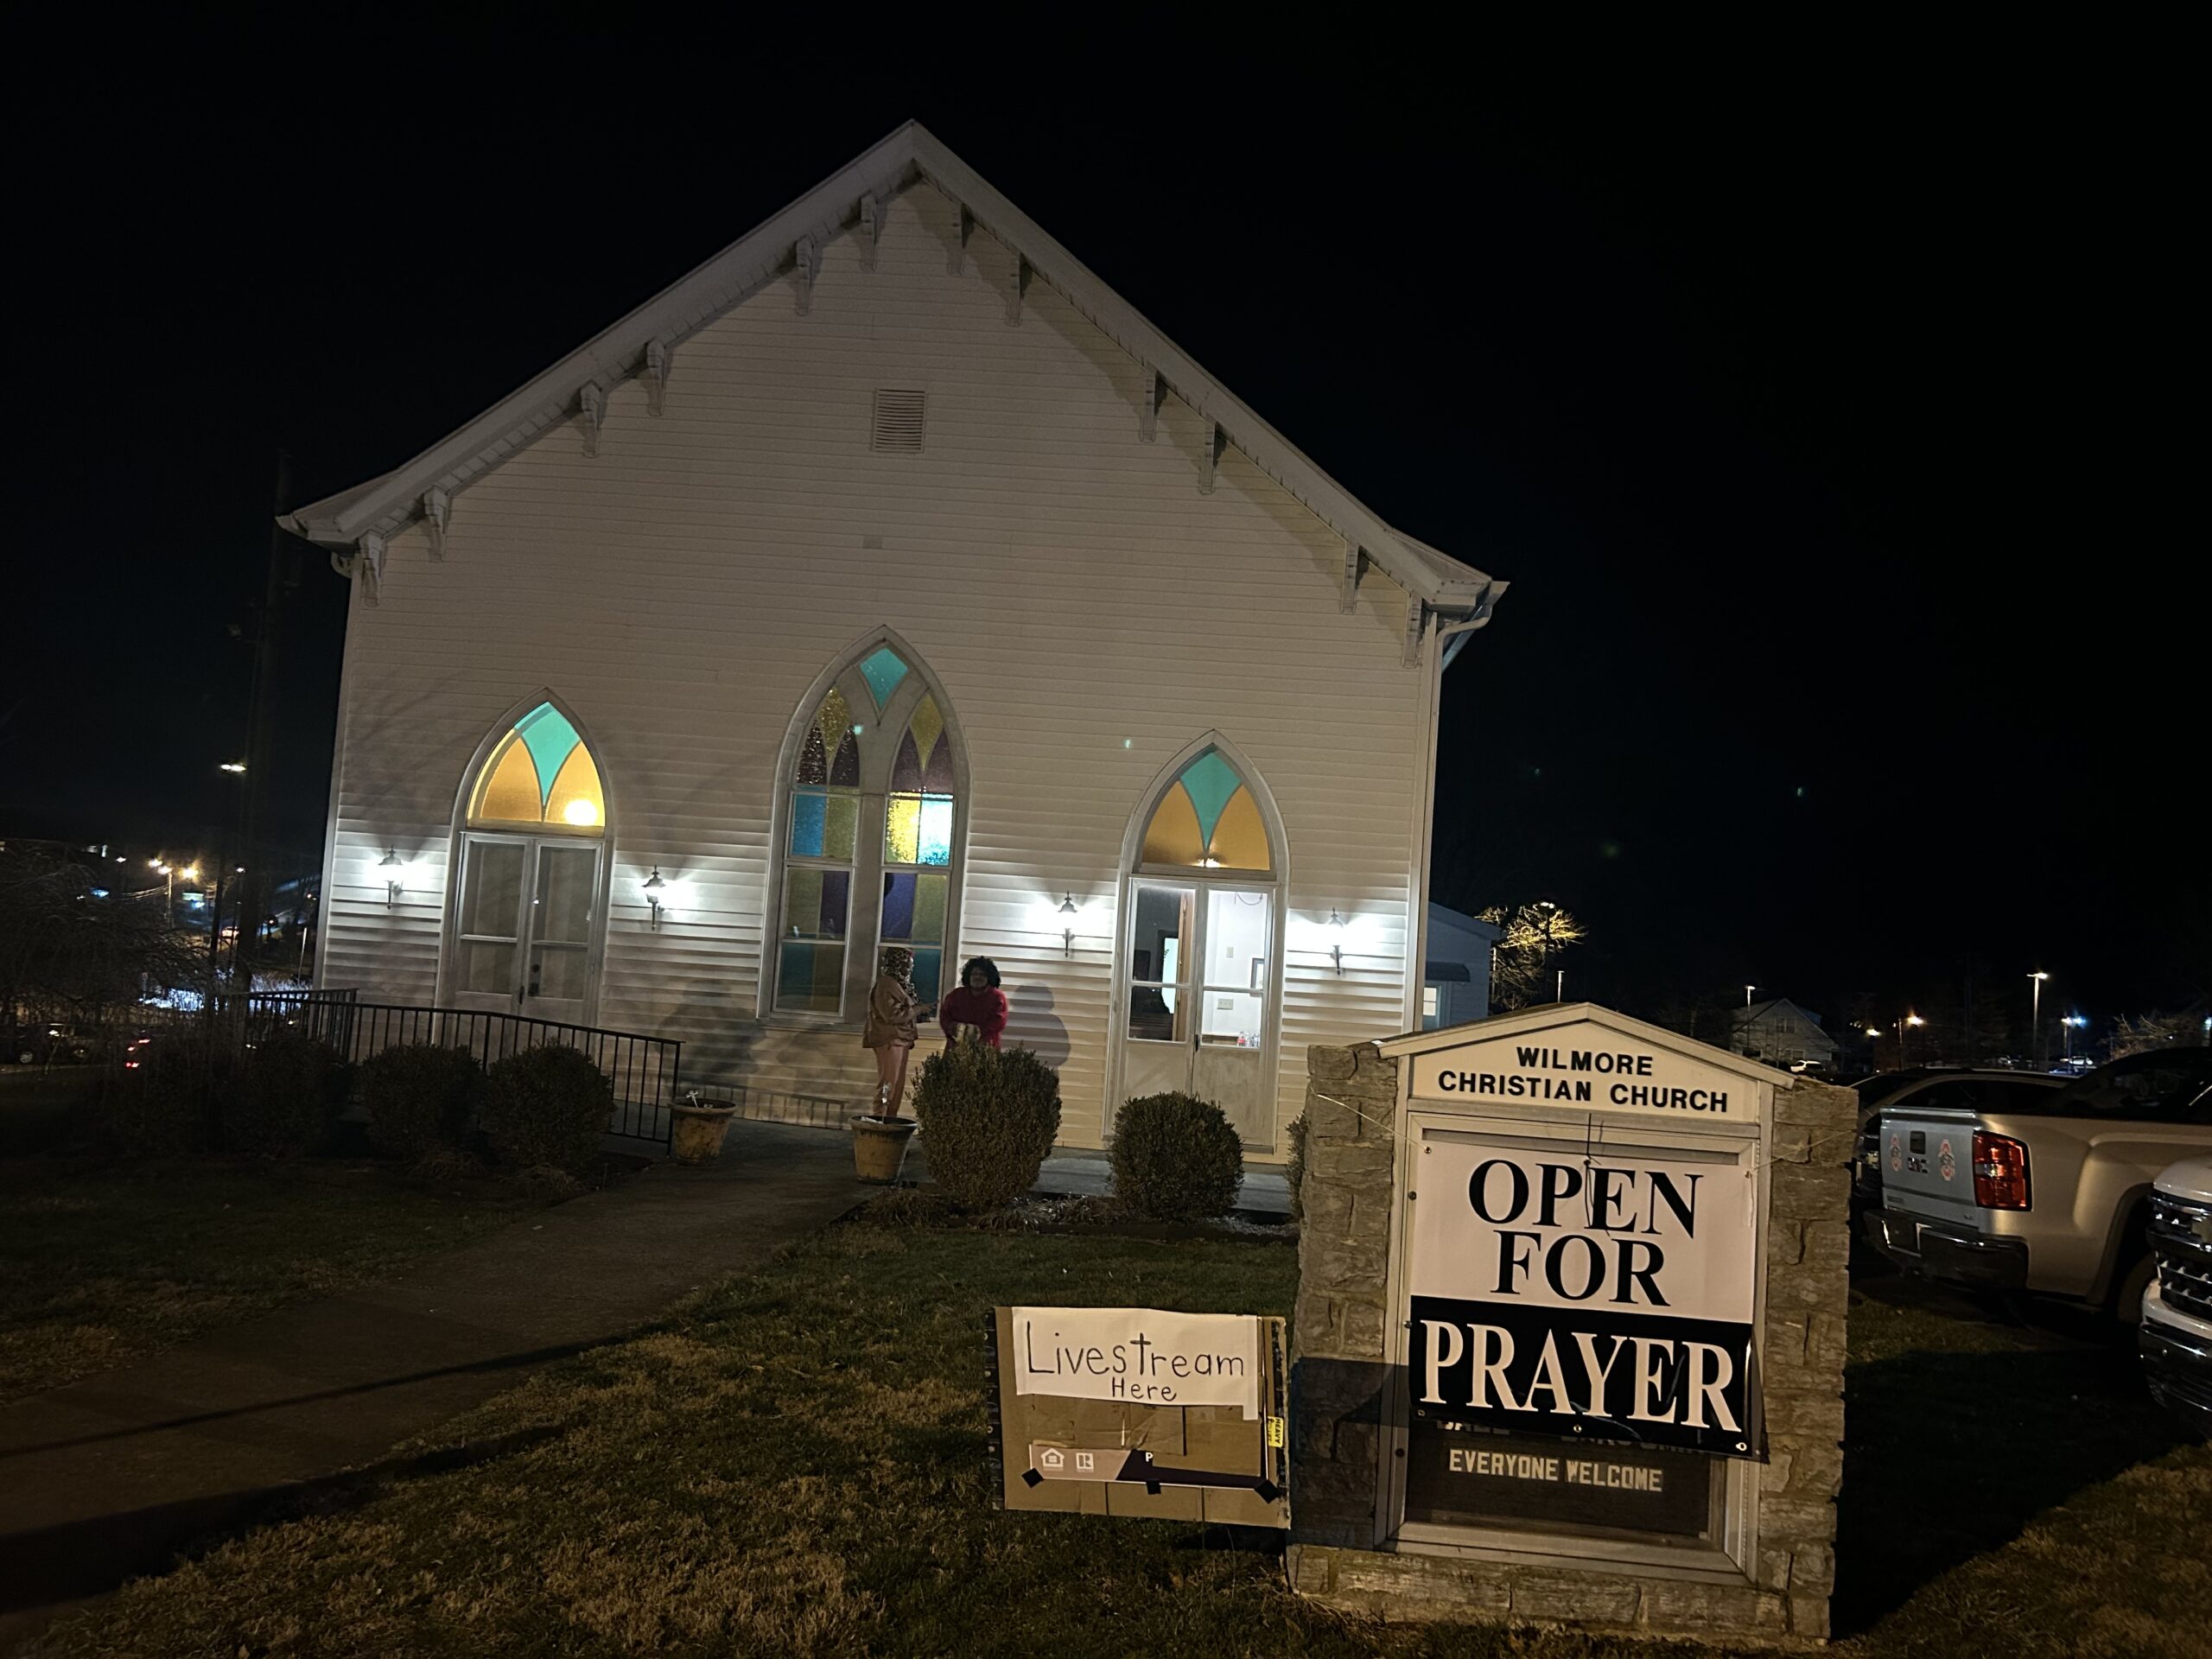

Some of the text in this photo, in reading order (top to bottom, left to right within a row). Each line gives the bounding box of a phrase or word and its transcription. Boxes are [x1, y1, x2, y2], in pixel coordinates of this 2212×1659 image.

[1516, 1046, 1653, 1077] WILMORE
[1438, 1071, 1728, 1113] CHRISTIAN CHURCH
[1468, 1159, 1705, 1239] OPEN
[1490, 1230, 1671, 1306] FOR
[1027, 1320, 1244, 1378] Livestream
[1111, 1376, 1177, 1402] Here
[1419, 1319, 1743, 1433] PRAYER
[1449, 1449, 1662, 1492] EVERYONE WELCOME
